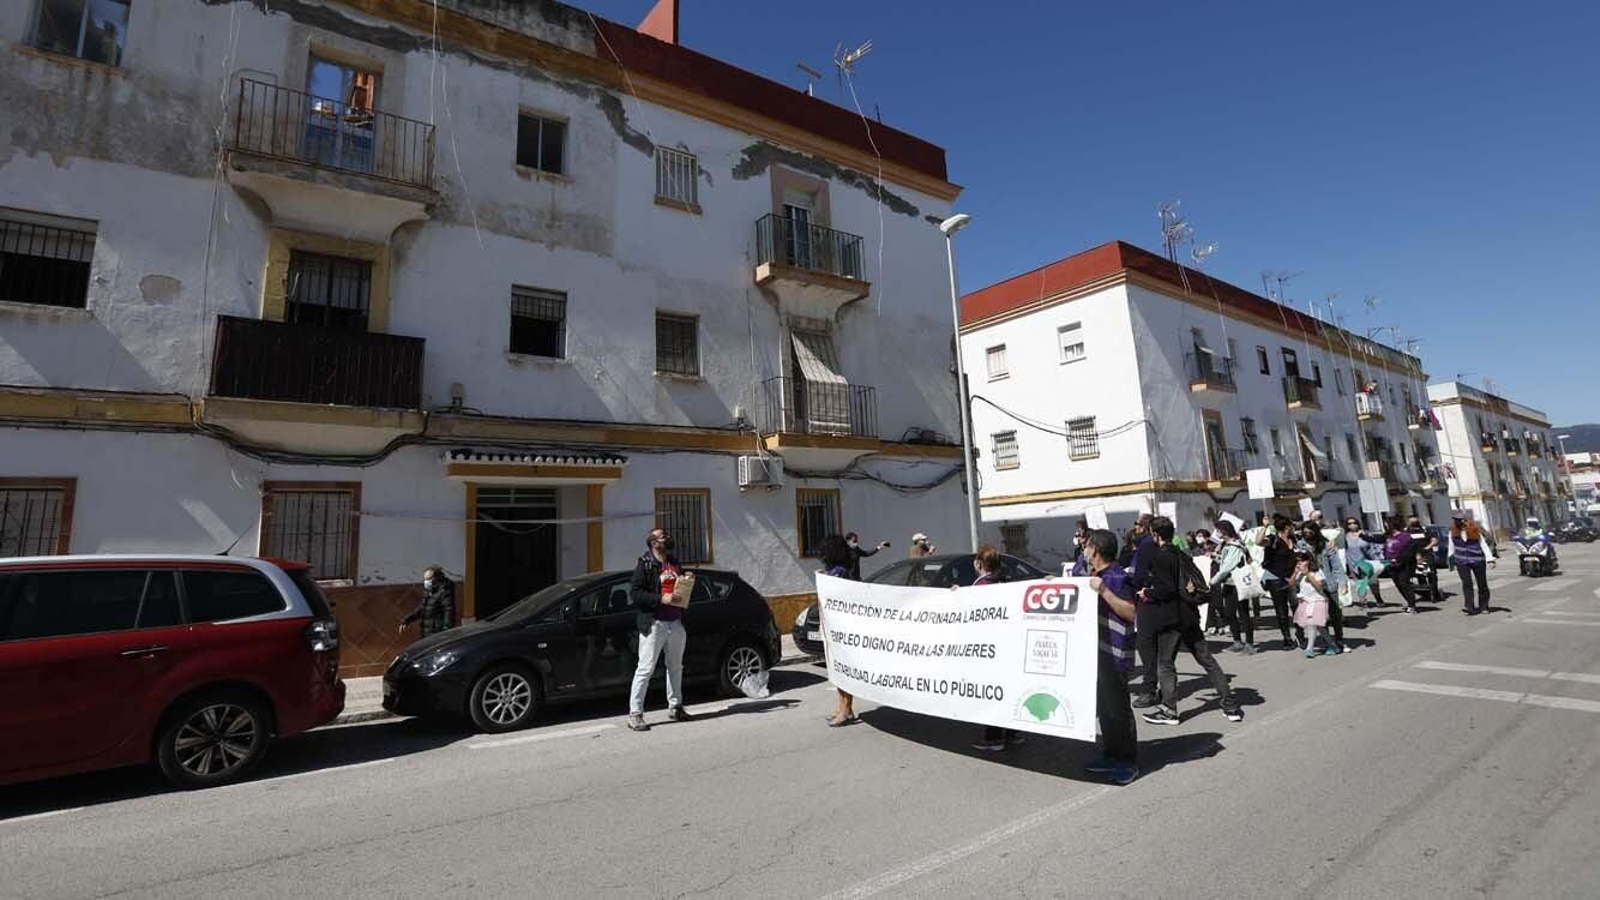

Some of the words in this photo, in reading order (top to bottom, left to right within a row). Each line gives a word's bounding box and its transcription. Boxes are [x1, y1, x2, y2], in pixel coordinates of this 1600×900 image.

[825, 597, 882, 619] REDUCCIÓN
[883, 608, 899, 620] DE
[899, 610, 912, 621] LA
[913, 610, 962, 624] JORNADA
[963, 606, 1009, 624] LABORAL
[1027, 588, 1076, 611] CGT
[830, 629, 861, 647] EMPLEO
[862, 635, 895, 653] DIGNO
[896, 641, 925, 657] PARA
[926, 643, 945, 657] LAS
[945, 643, 996, 659] MUJERES
[870, 672, 914, 691] LABORAL
[916, 677, 931, 692] EN
[933, 678, 948, 695] LO
[950, 677, 1004, 701] PÚBLICO
